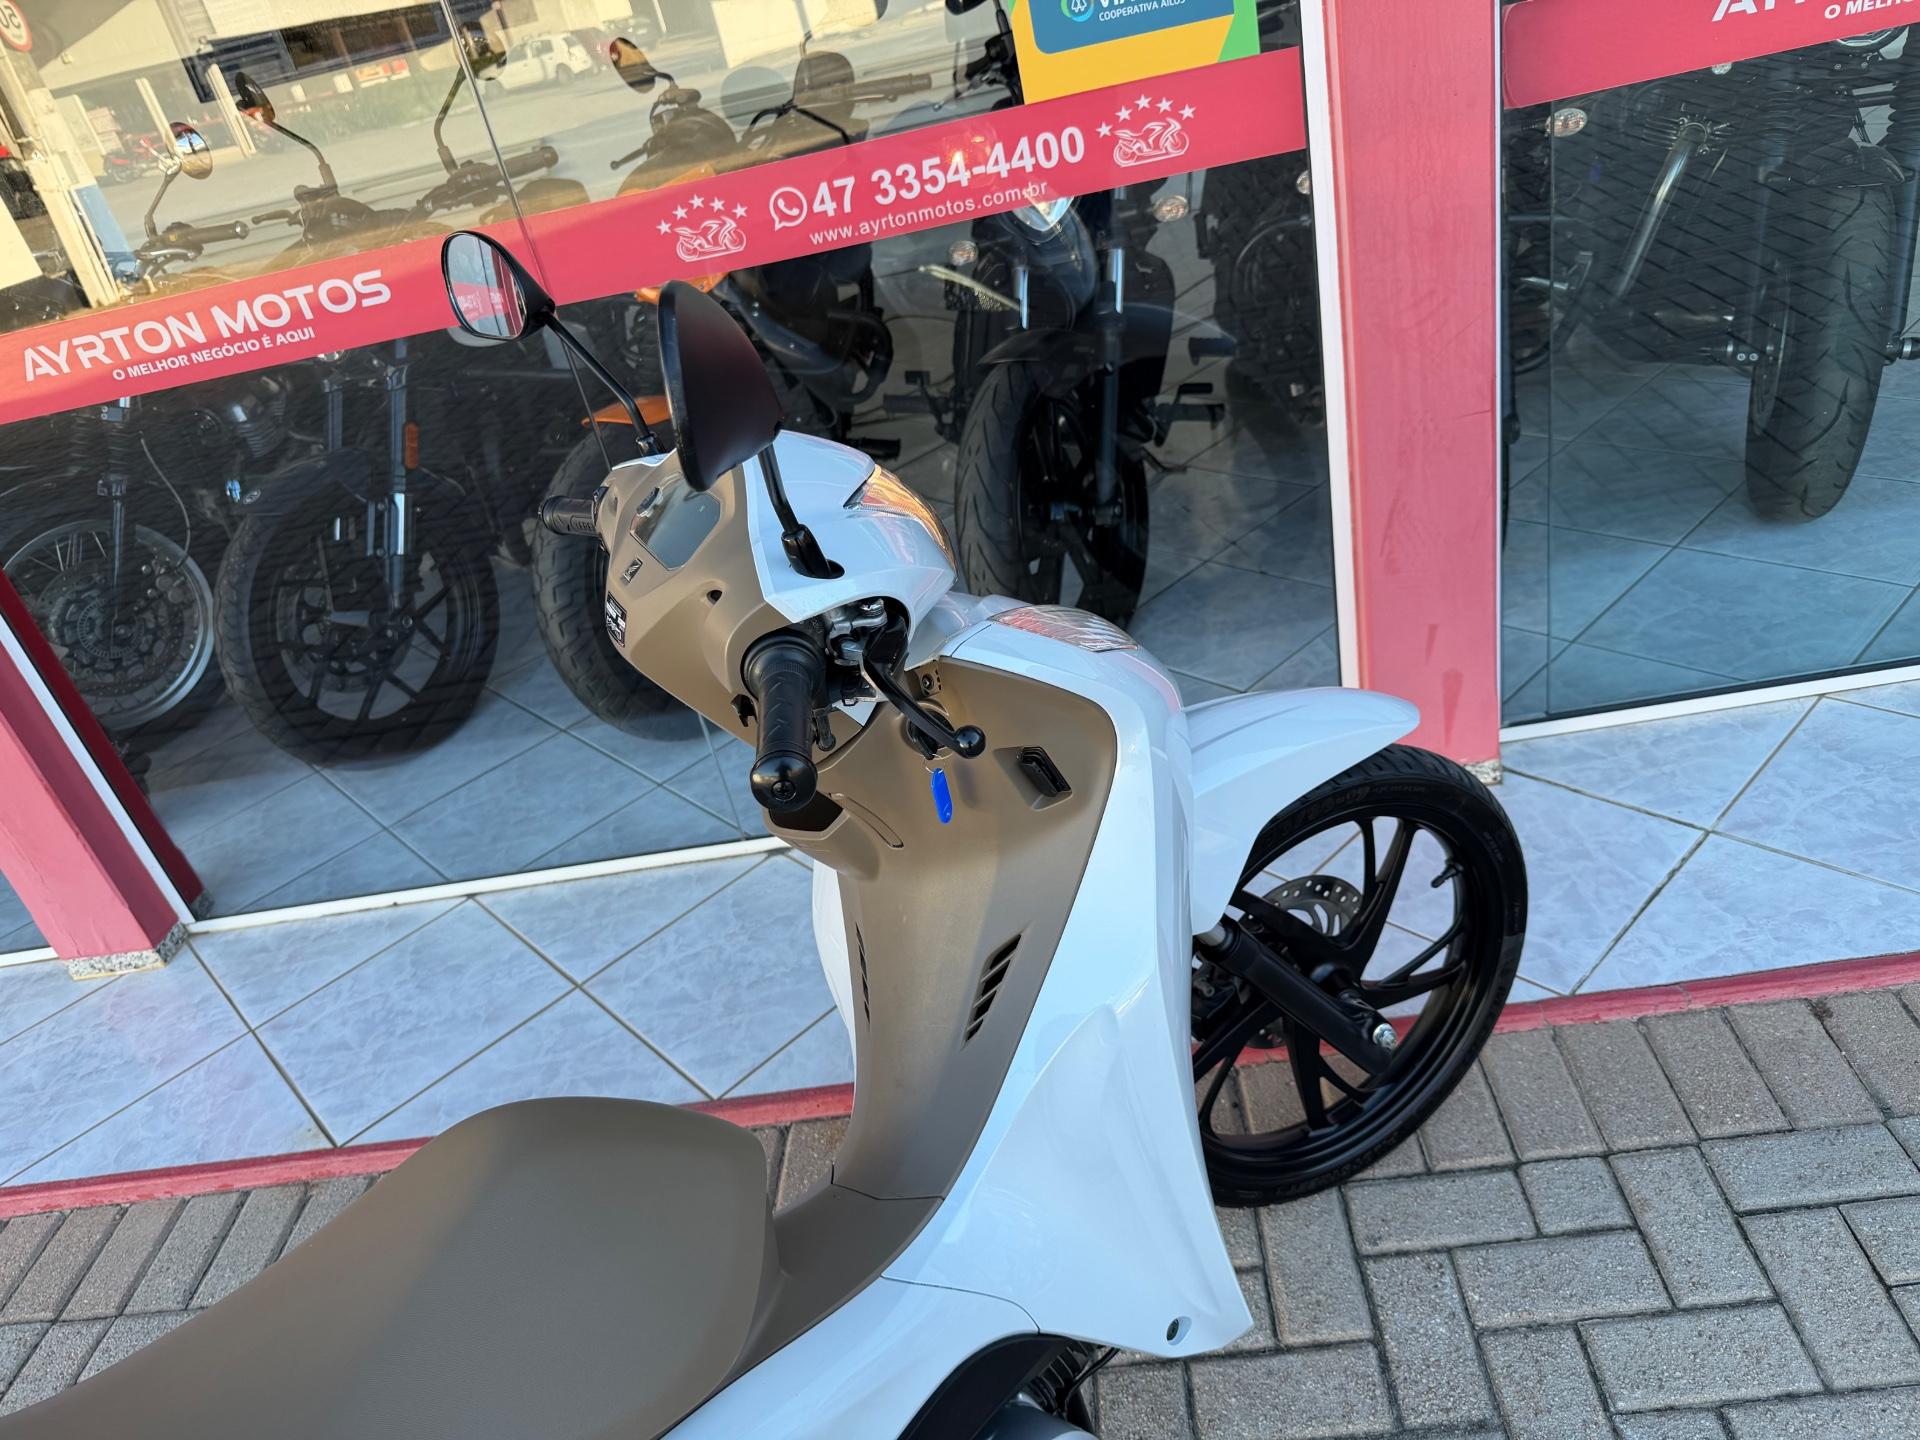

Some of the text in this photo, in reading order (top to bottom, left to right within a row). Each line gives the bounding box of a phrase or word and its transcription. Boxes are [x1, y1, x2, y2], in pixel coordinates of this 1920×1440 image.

[1099, 1, 1159, 21] COOPERATIVA
[1824, 4, 1841, 19] O
[812, 126, 1085, 217] 47 3354-4400
[809, 180, 1048, 246] www.ayrtonmotos.com.br
[23, 269, 391, 381] AYRTON MOTOS
[112, 326, 316, 381] O MELHOR NEGÓCIO É AQUI
